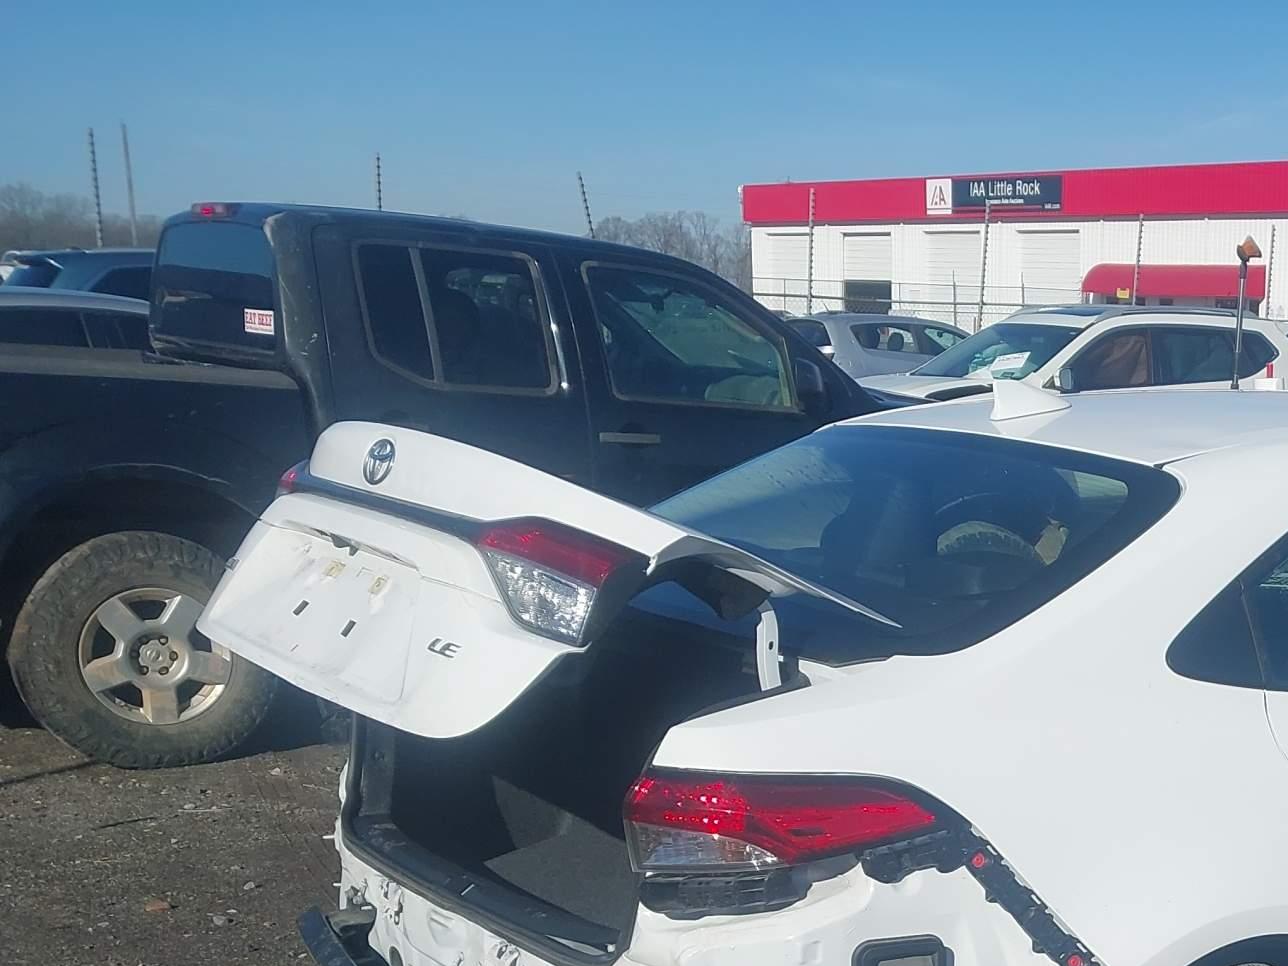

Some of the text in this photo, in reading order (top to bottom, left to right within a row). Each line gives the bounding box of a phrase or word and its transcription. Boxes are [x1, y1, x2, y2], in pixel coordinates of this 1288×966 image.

[970, 180, 1041, 197] IAA Little Rock
[427, 638, 462, 659] LE
